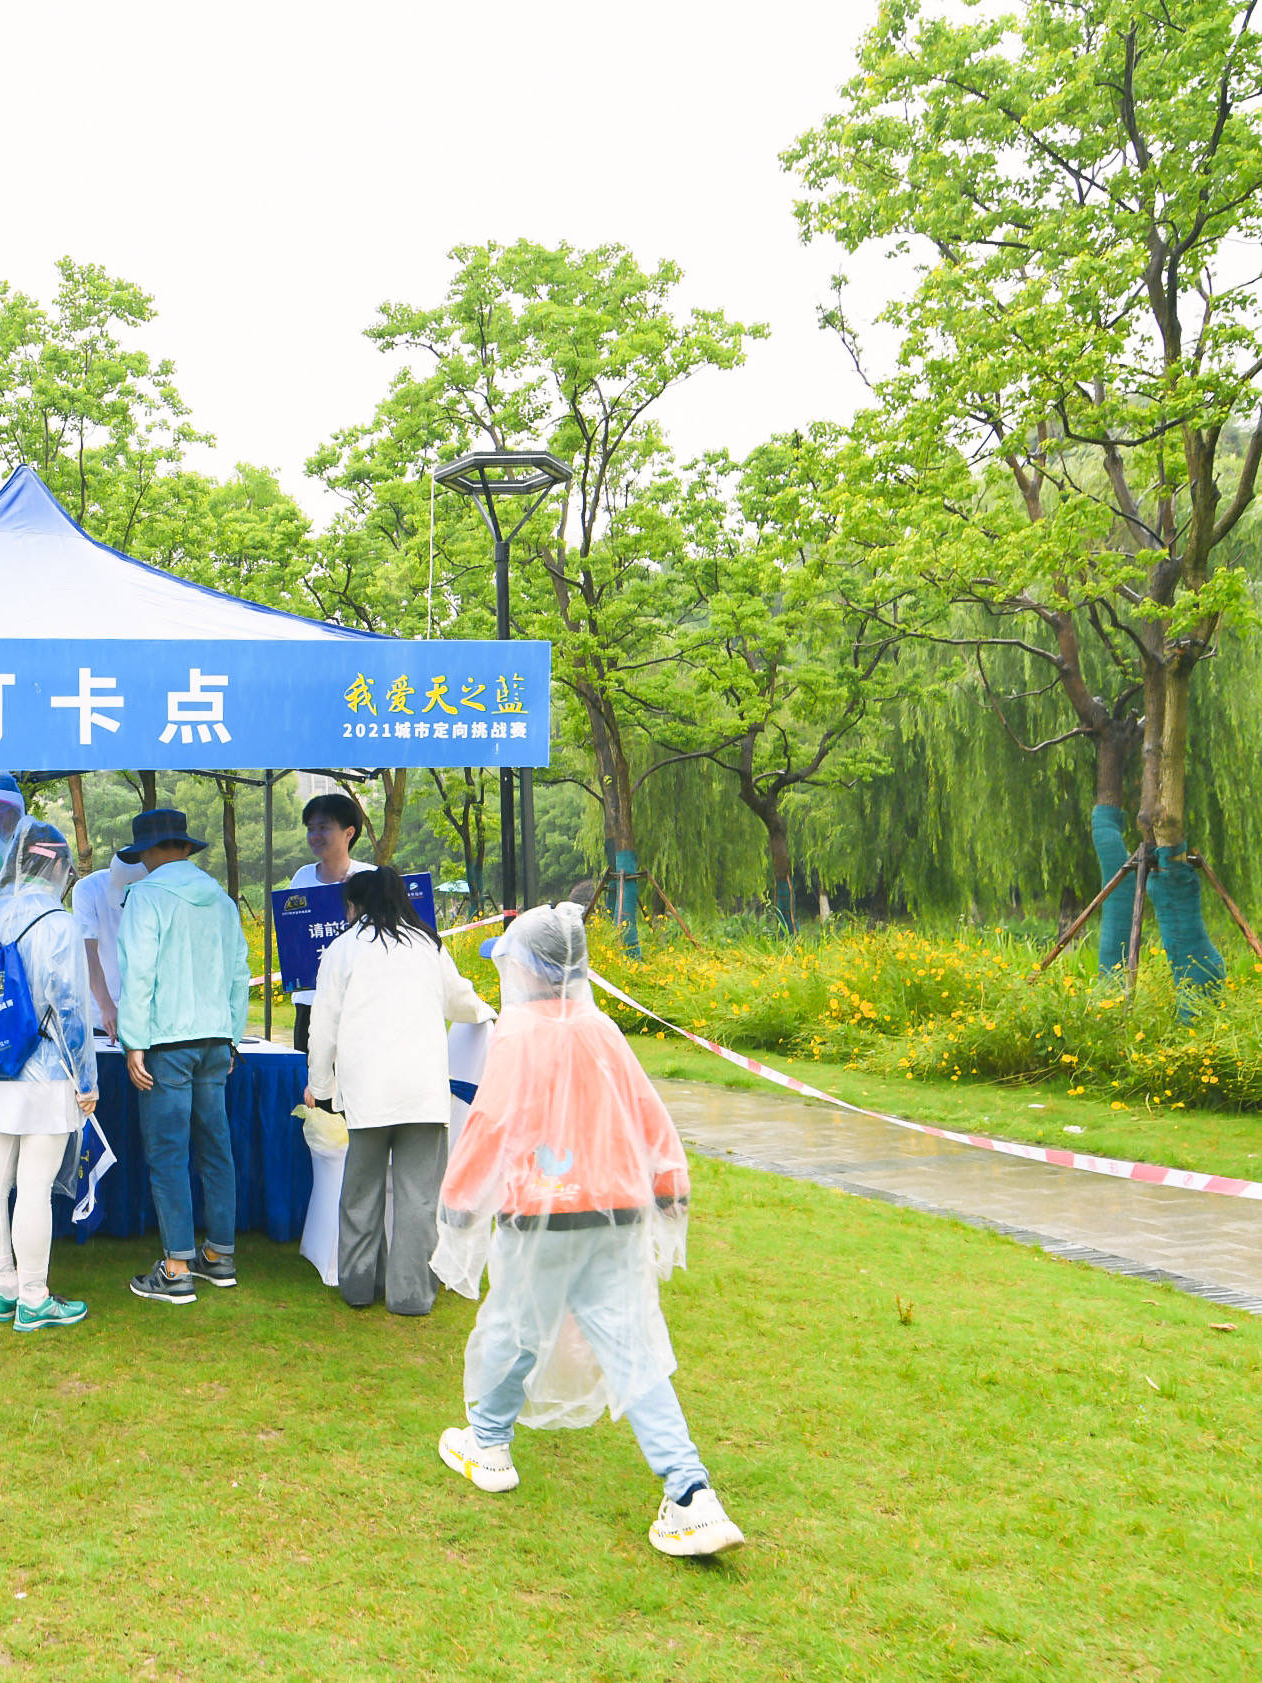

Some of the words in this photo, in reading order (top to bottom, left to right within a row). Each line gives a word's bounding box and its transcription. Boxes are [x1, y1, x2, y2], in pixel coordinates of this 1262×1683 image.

[342, 721, 528, 740] 2021城市定向挑战赛
